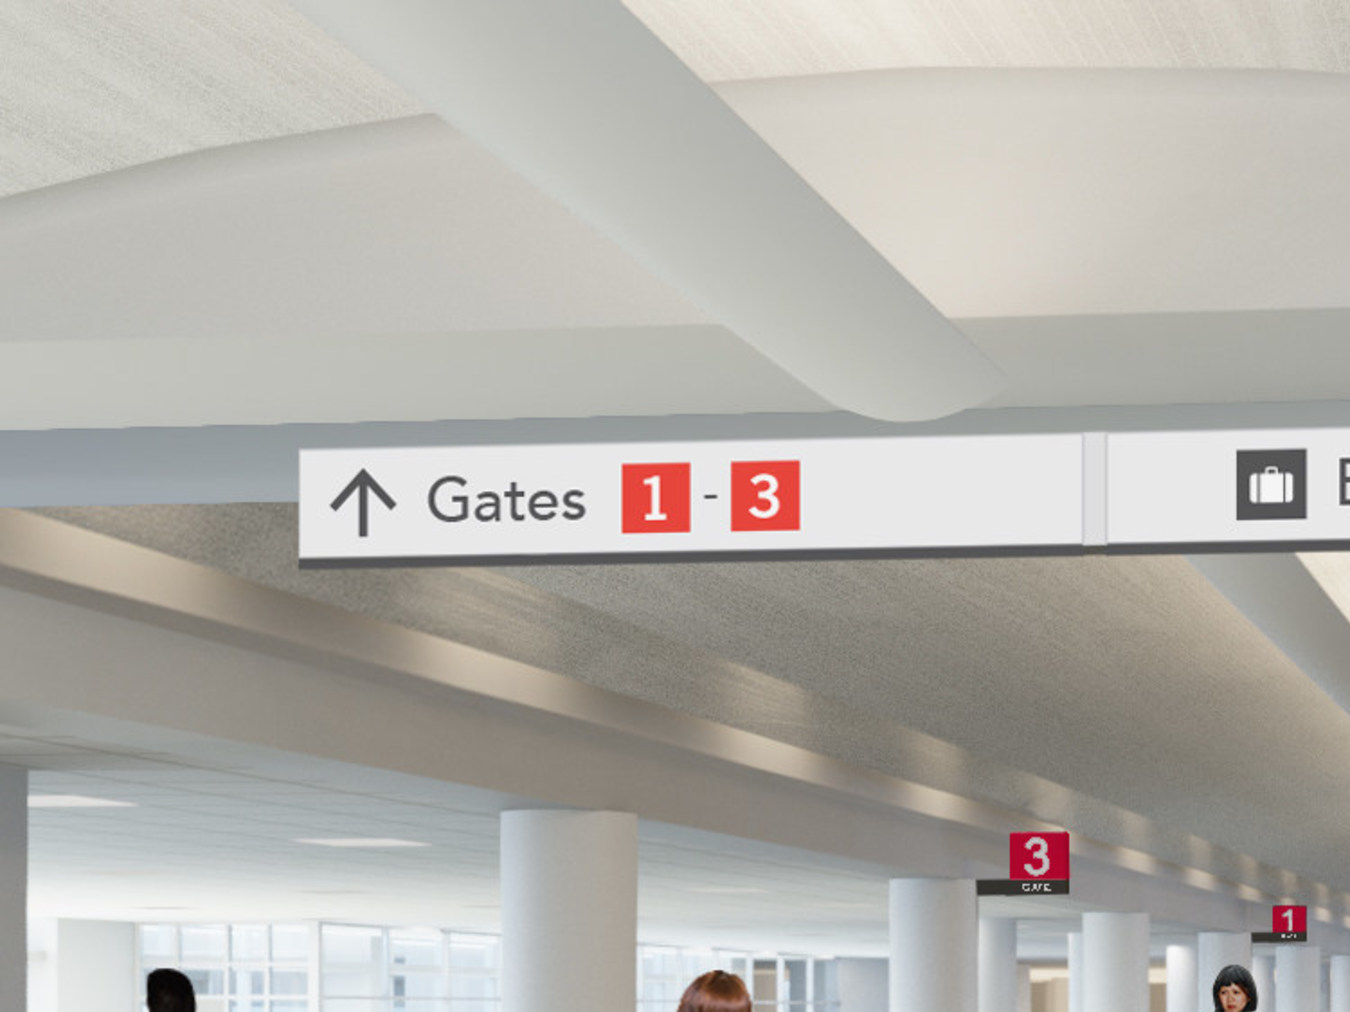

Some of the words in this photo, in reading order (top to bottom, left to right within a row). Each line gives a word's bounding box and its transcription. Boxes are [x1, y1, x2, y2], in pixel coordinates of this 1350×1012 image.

[427, 475, 587, 523] Gates
[642, 475, 668, 522] 1
[748, 473, 780, 520] 3
[1024, 836, 1050, 877] 3
[1281, 908, 1294, 932] 1
